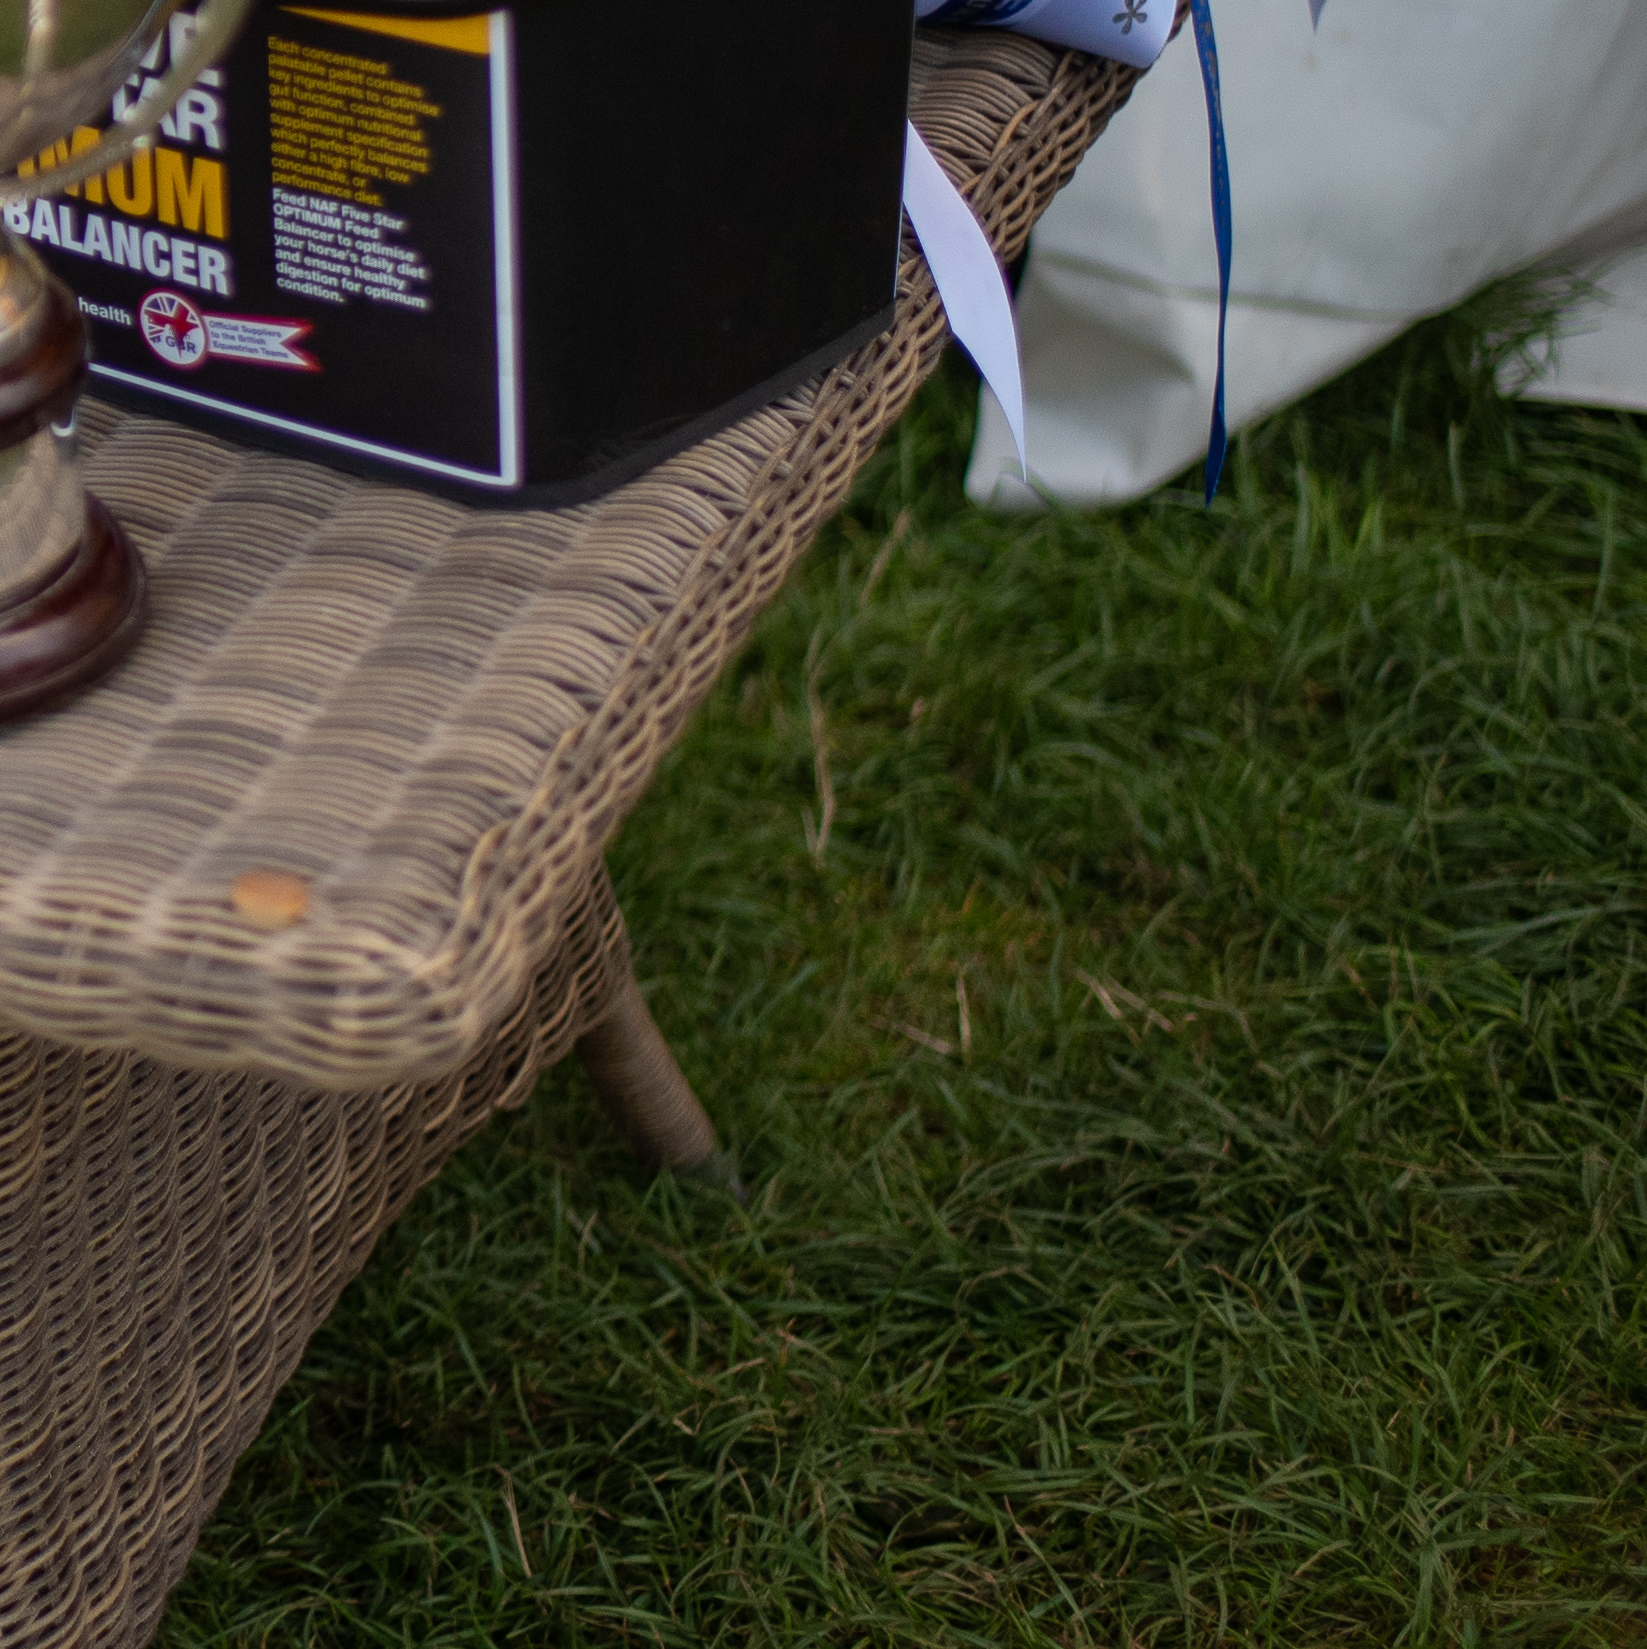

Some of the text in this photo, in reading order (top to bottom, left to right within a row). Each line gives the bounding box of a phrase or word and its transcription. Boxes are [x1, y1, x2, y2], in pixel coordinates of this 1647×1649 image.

[273, 187, 405, 230] Feed NAF Five Star
[273, 203, 381, 239] OPTIMUM Feed
[3, 196, 230, 297] BALANCER
[274, 217, 416, 263] Balancer to optimise
[274, 233, 304, 249] your
[361, 254, 396, 273] daily
[397, 263, 427, 280] diet
[275, 249, 406, 291] and ensure healthy
[276, 262, 427, 309] digestion for optimum
[277, 277, 344, 303] condition.
[78, 296, 132, 326] health
[209, 319, 239, 333] Official
[242, 324, 282, 338] Suppliers
[211, 331, 220, 340] to
[222, 331, 235, 342] the
[213, 340, 259, 355] Equestrian
